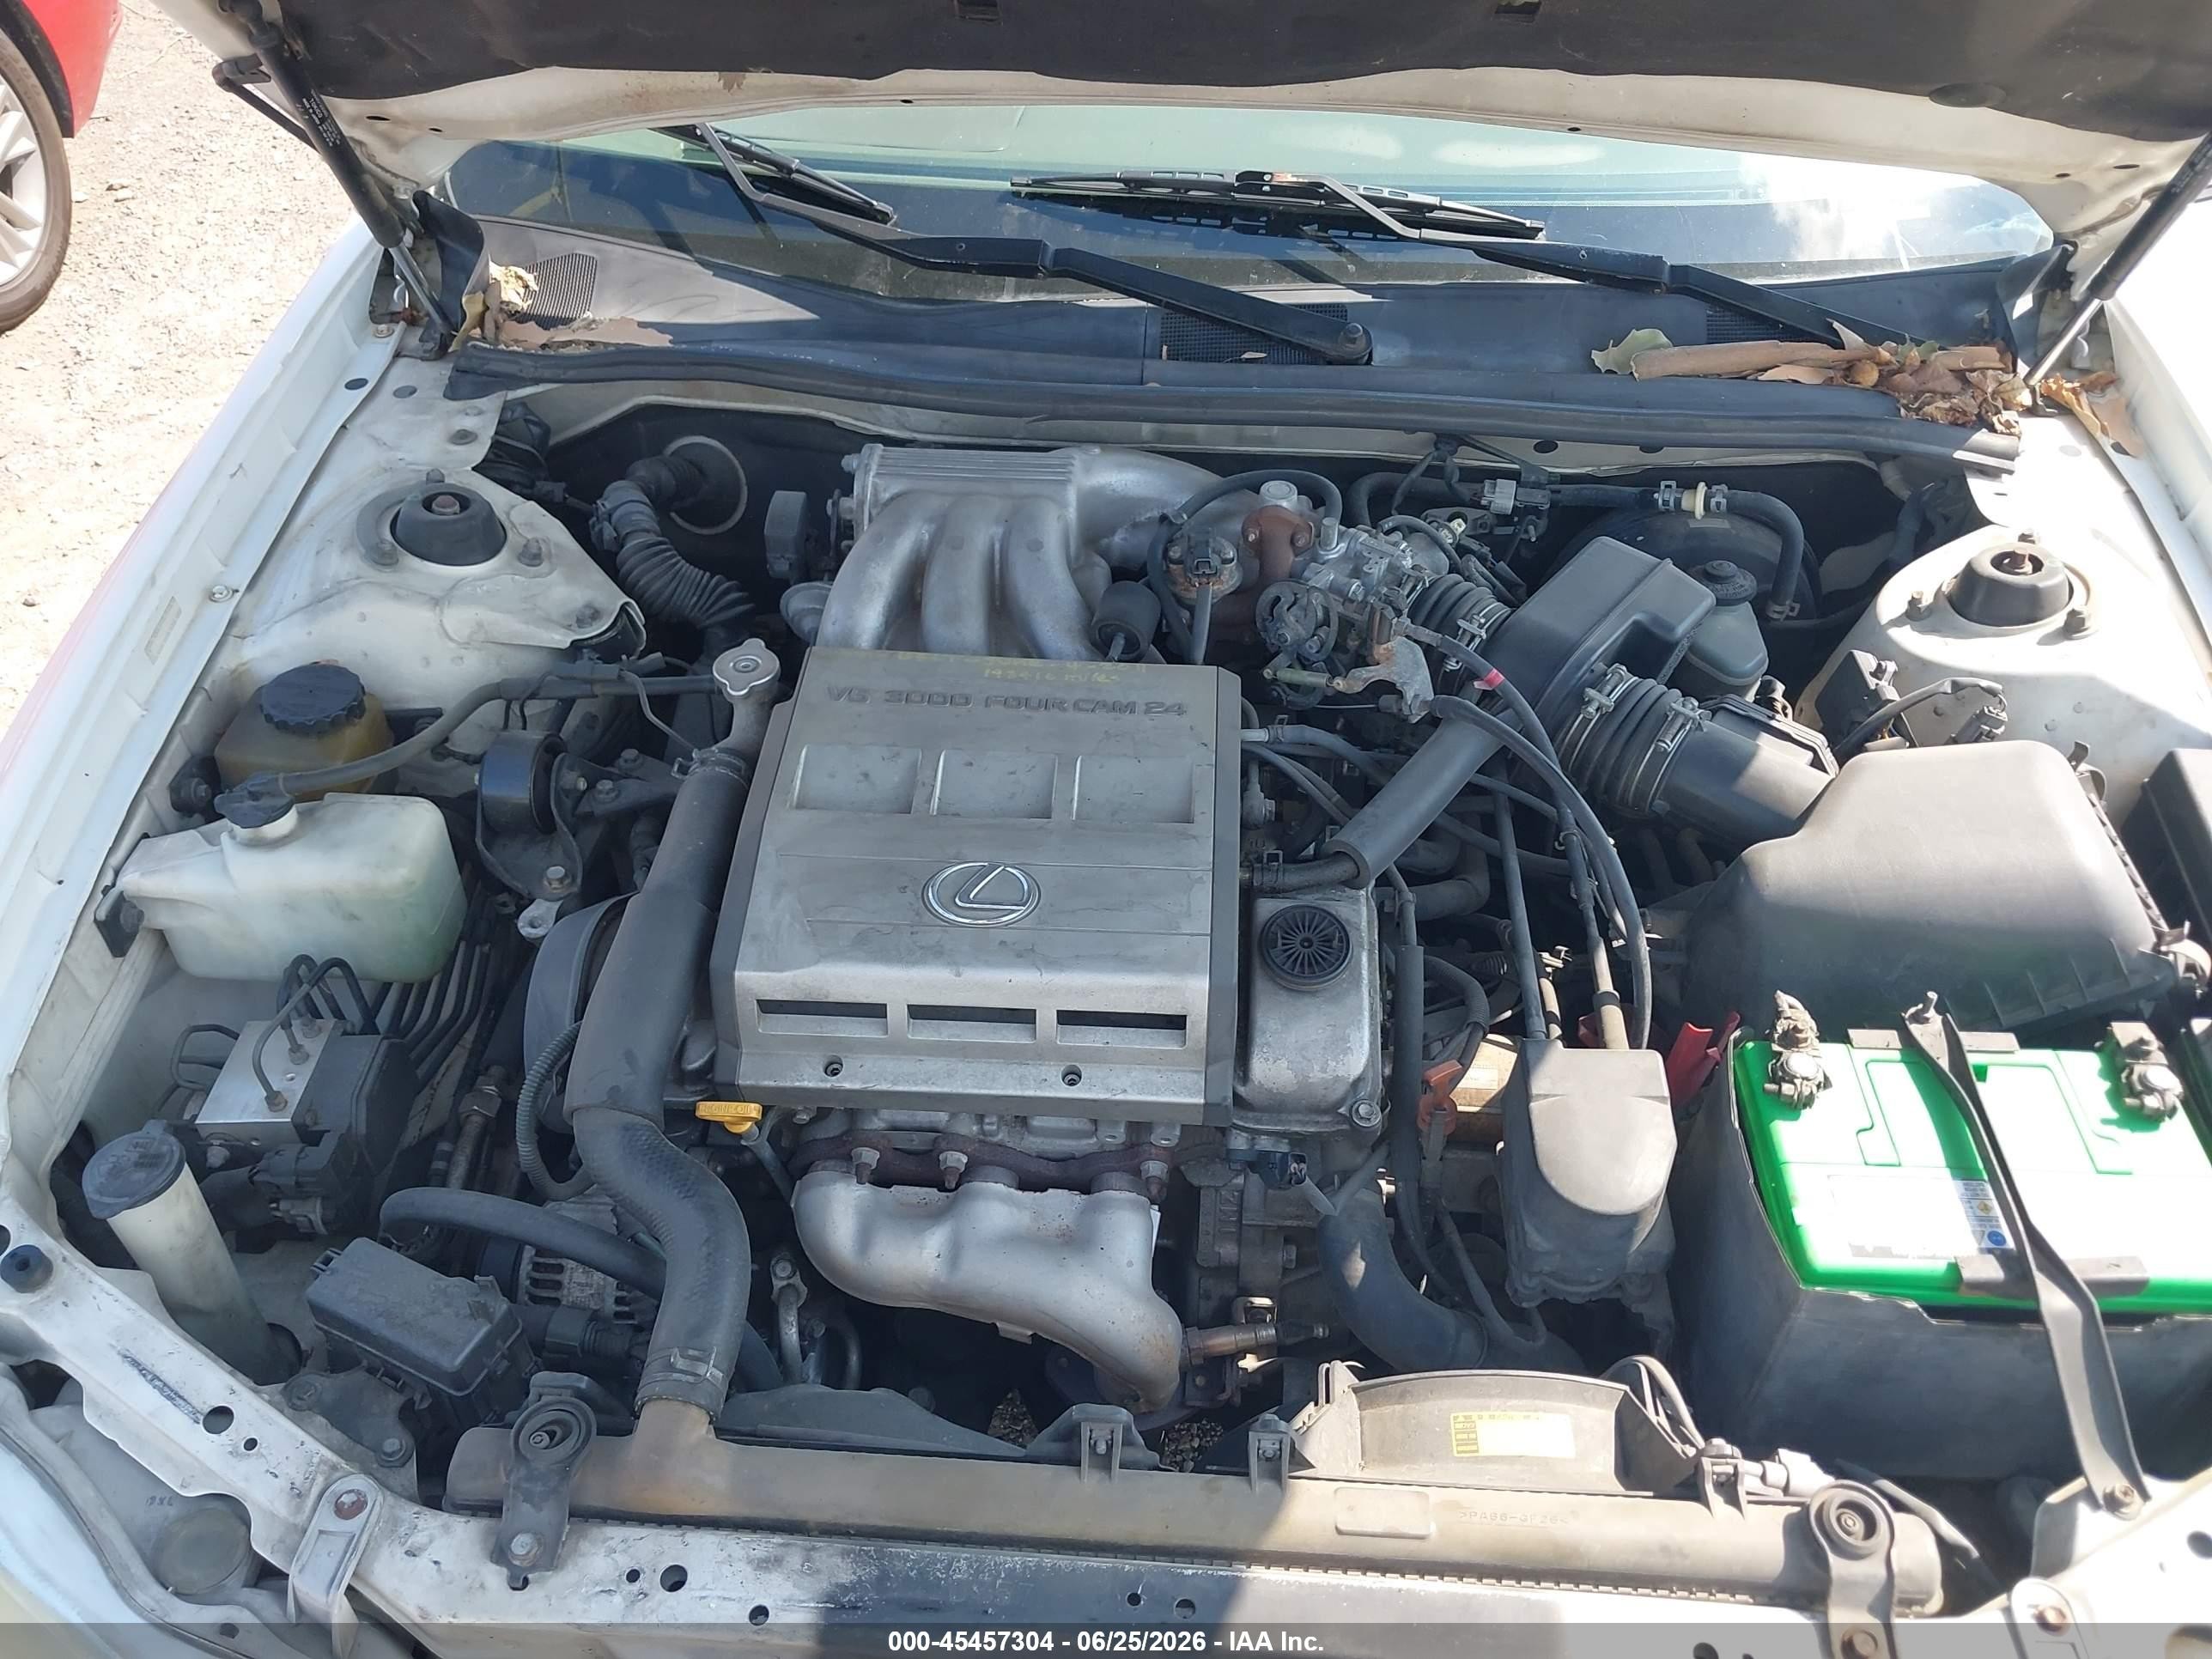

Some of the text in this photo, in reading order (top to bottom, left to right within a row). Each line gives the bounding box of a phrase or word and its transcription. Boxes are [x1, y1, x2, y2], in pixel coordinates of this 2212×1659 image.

[826, 684, 1187, 716] V6 3000 FOUR CAM 24
